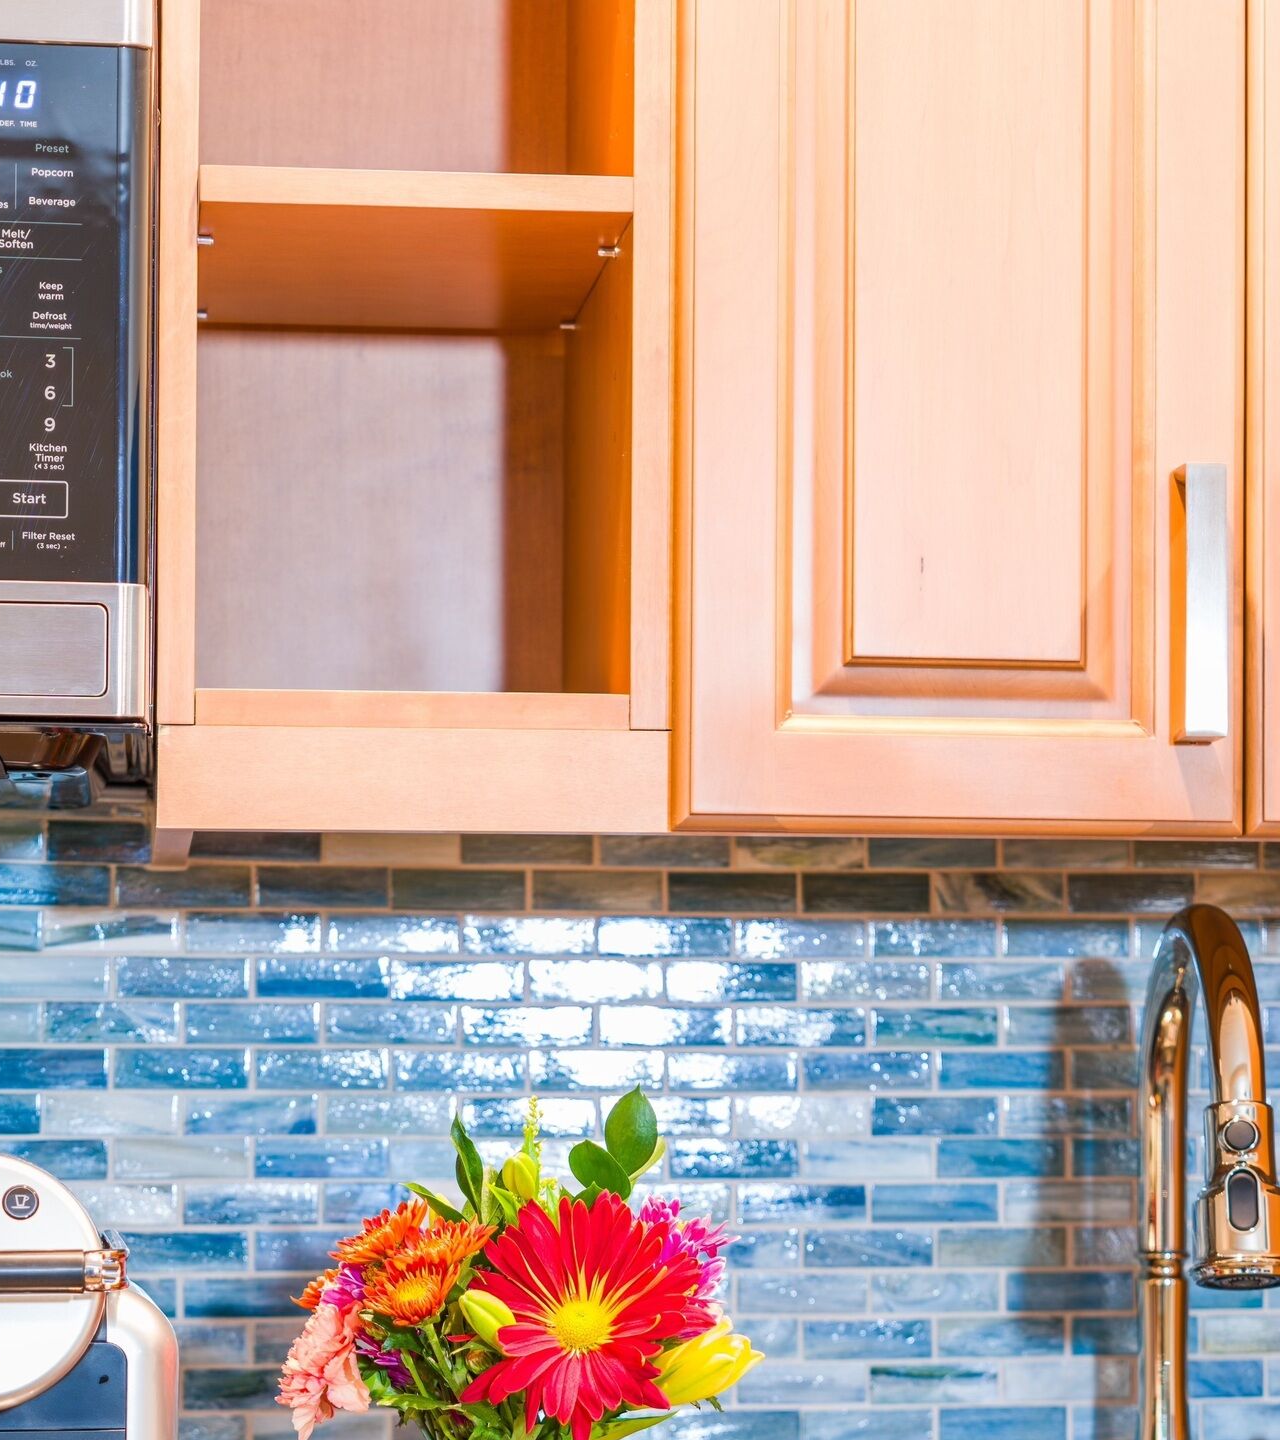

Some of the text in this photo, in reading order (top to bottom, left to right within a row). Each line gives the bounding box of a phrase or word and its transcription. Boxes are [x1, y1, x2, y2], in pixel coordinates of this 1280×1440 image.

[36, 144, 68, 153] Preset
[32, 168, 73, 177] Popcorn
[29, 197, 75, 207] Beverage
[0, 229, 30, 240] Melt/
[0, 238, 33, 248] Soften
[40, 282, 63, 291] Keep
[33, 312, 66, 320] Defrost
[30, 322, 72, 330] time/weight
[45, 354, 55, 368] 3
[45, 386, 55, 400] 6
[45, 418, 55, 431] 9
[30, 443, 67, 452] Kitchen
[35, 454, 64, 462] Timer
[13, 493, 46, 504] Start
